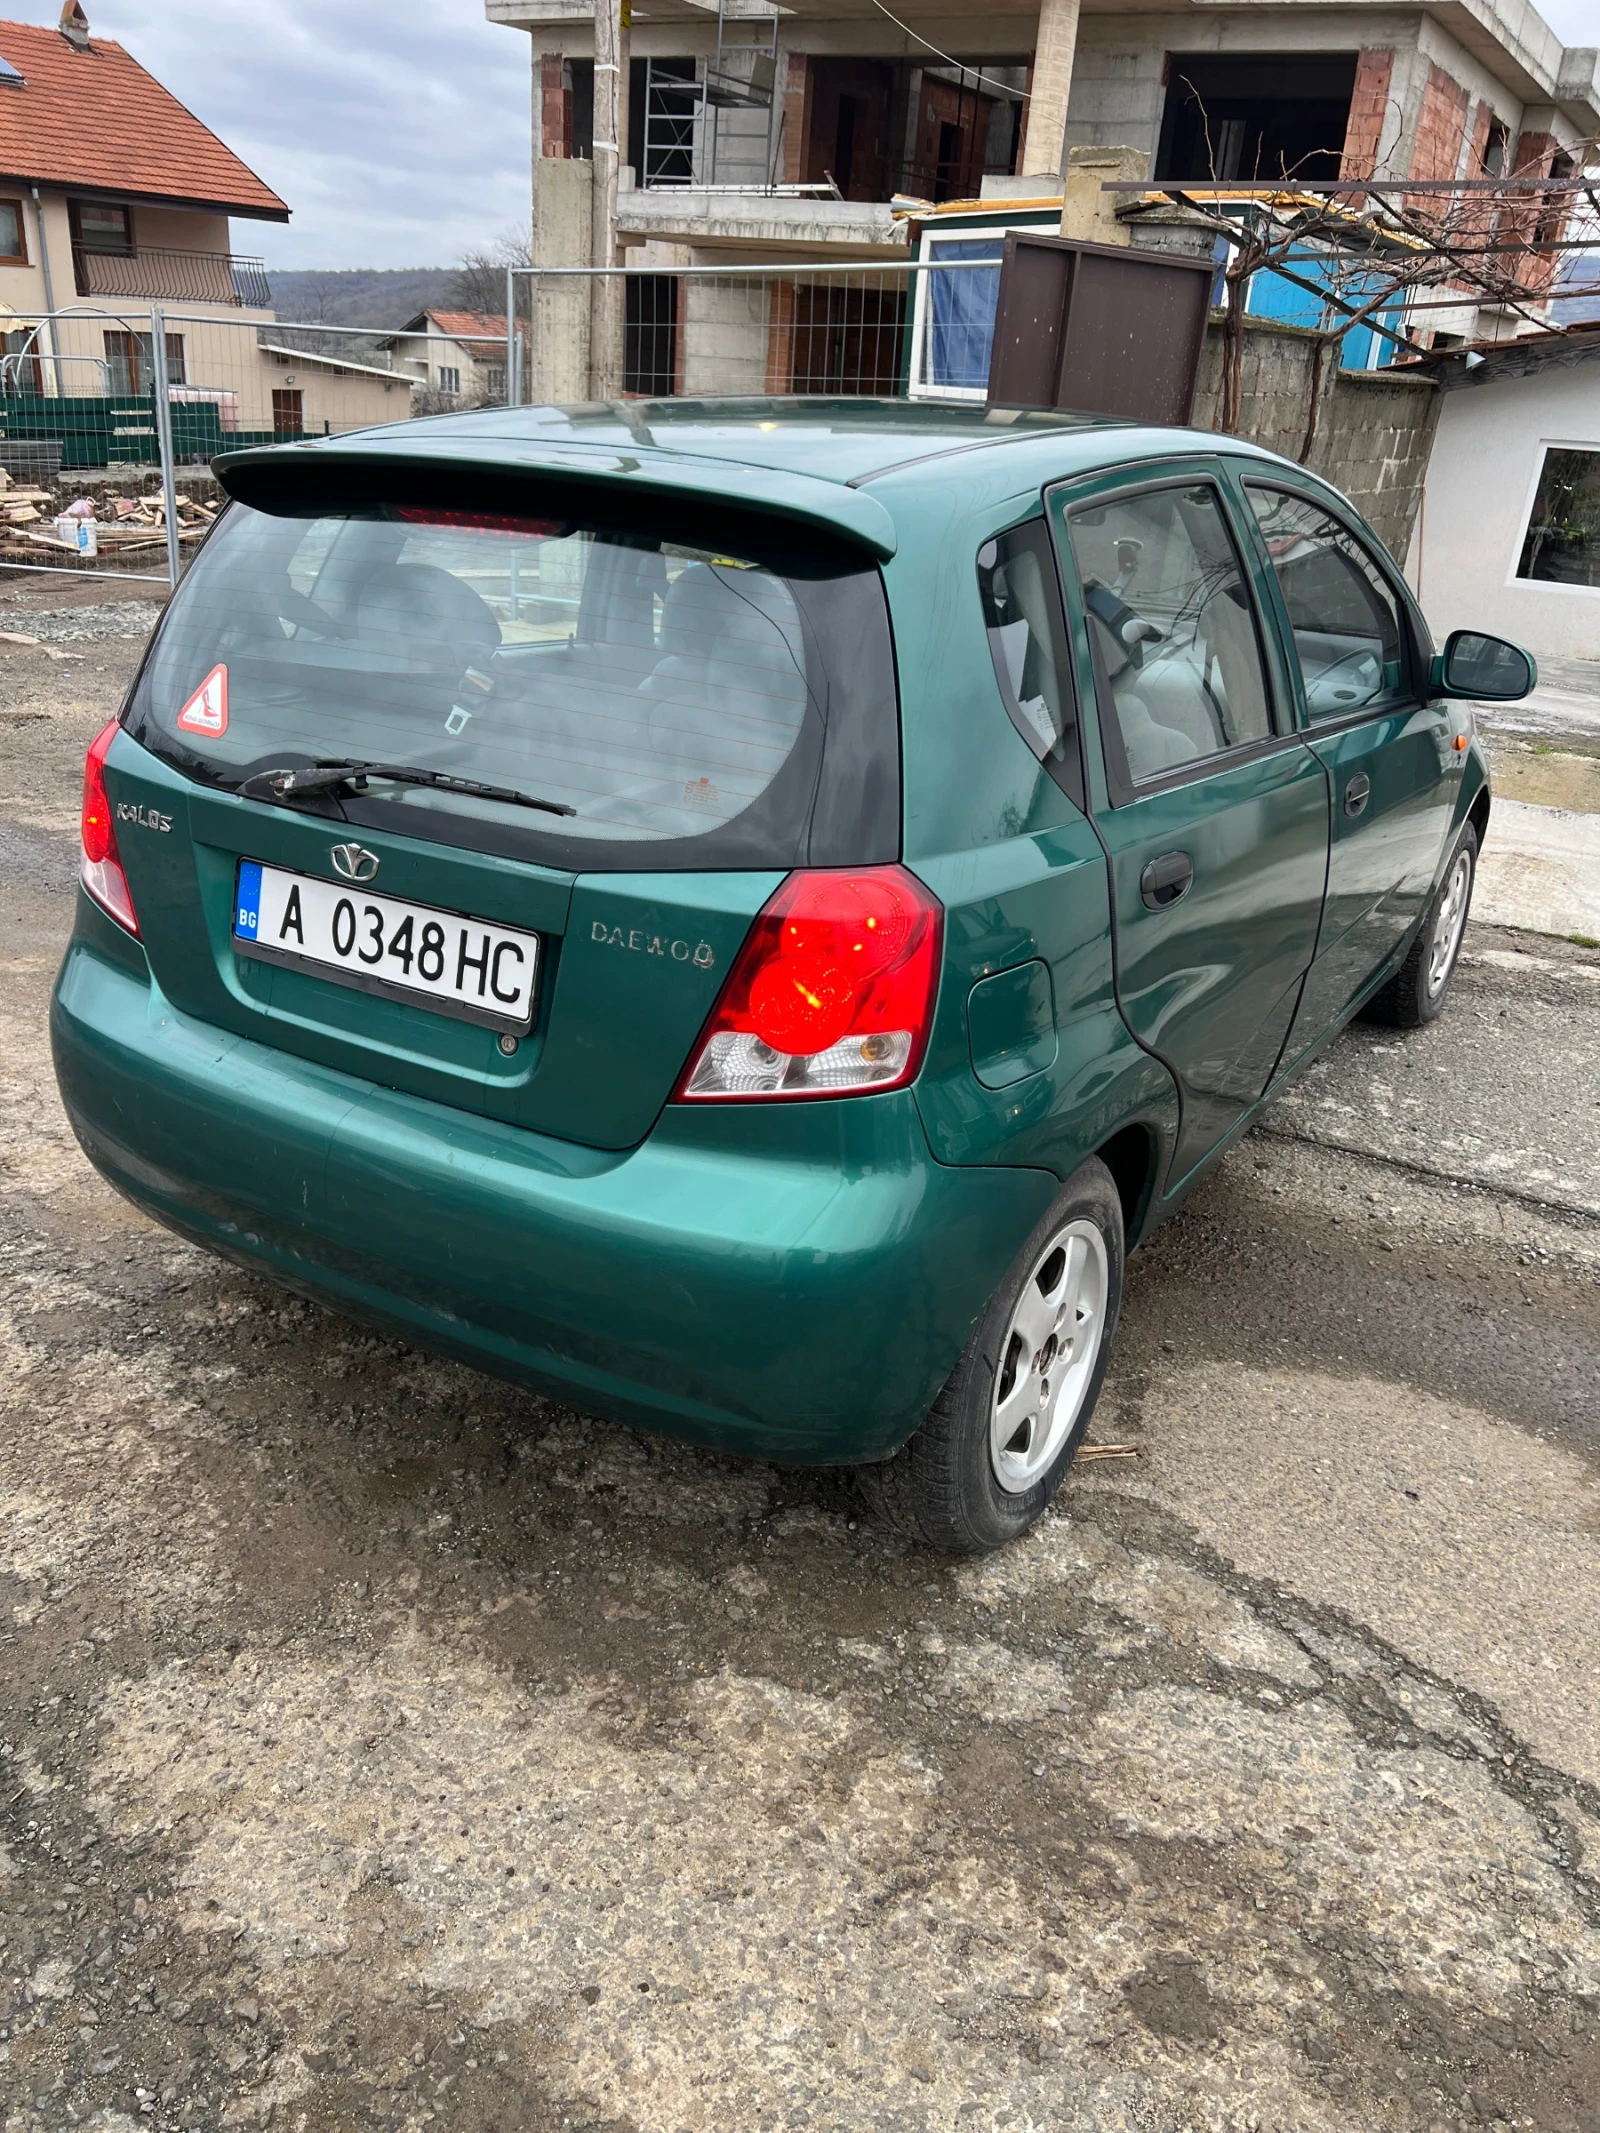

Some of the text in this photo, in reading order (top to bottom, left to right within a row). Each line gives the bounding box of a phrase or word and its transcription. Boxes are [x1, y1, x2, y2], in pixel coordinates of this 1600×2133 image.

[116, 802, 173, 833] KALOS
[239, 908, 257, 928] BG
[279, 884, 524, 1003] A 0348 HC
